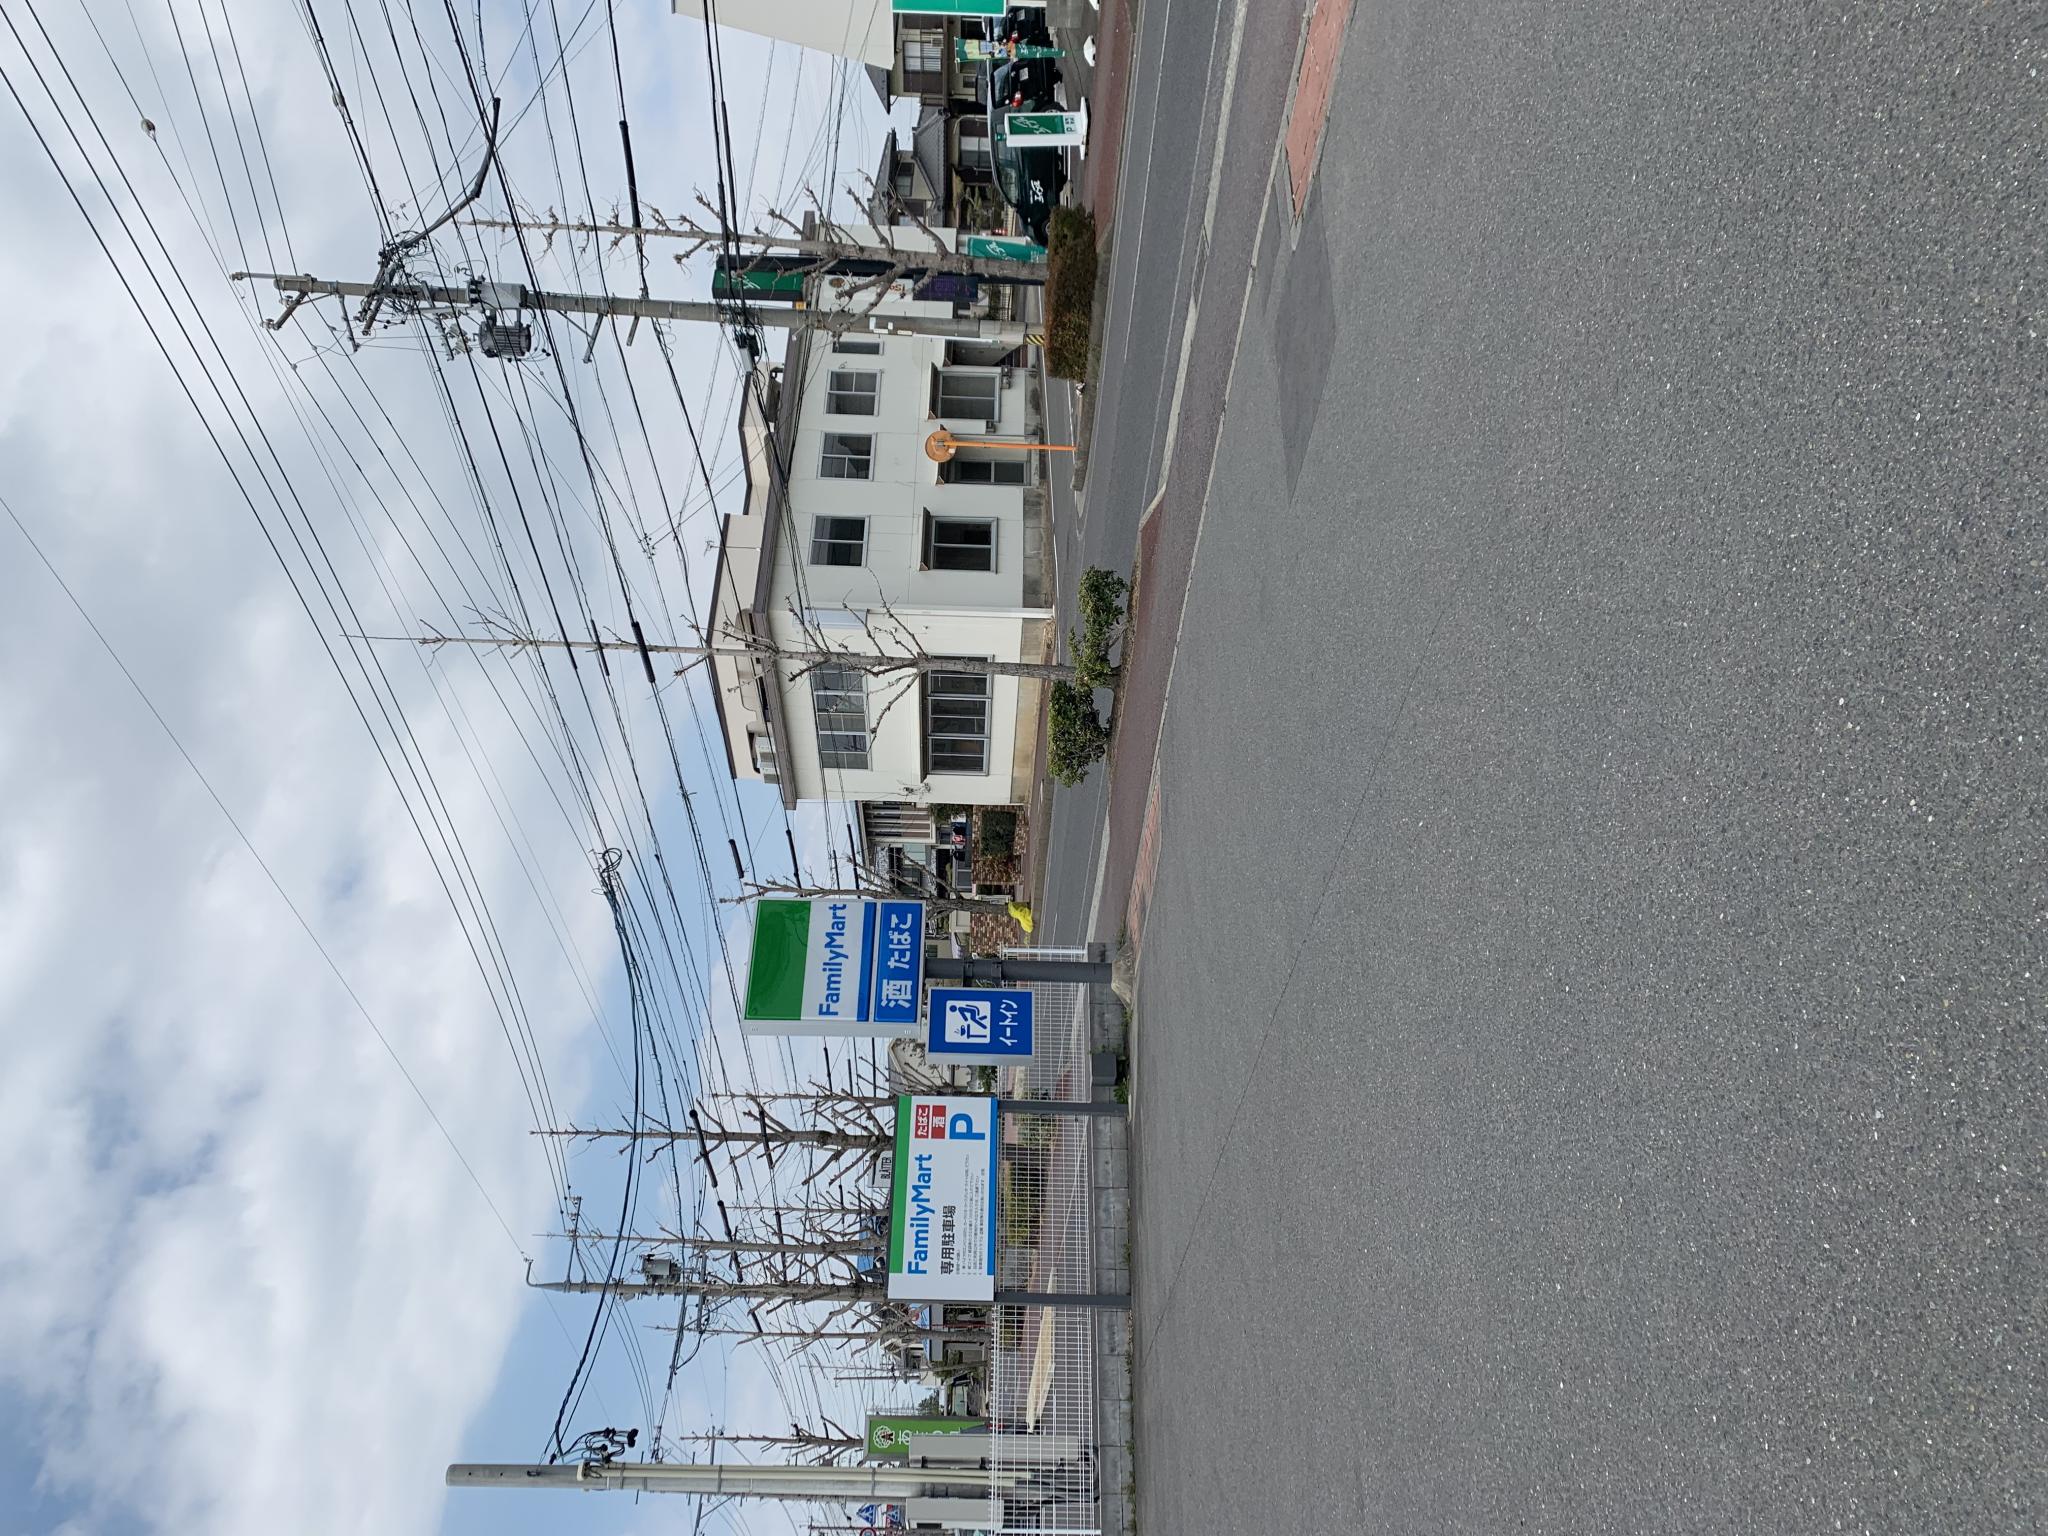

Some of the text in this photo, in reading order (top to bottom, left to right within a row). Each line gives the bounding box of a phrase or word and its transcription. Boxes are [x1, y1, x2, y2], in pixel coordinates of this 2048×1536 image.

[818, 904, 849, 1016] FamilyMart
[880, 913, 913, 1008] 酒 たばこ
[998, 999, 1018, 1046] イートイン
[917, 1107, 929, 1136] たばこ
[932, 1116, 945, 1128] 酒
[949, 1113, 985, 1140] P
[907, 1154, 935, 1275] FamilyMart
[940, 1205, 956, 1275] 専用駐車場
